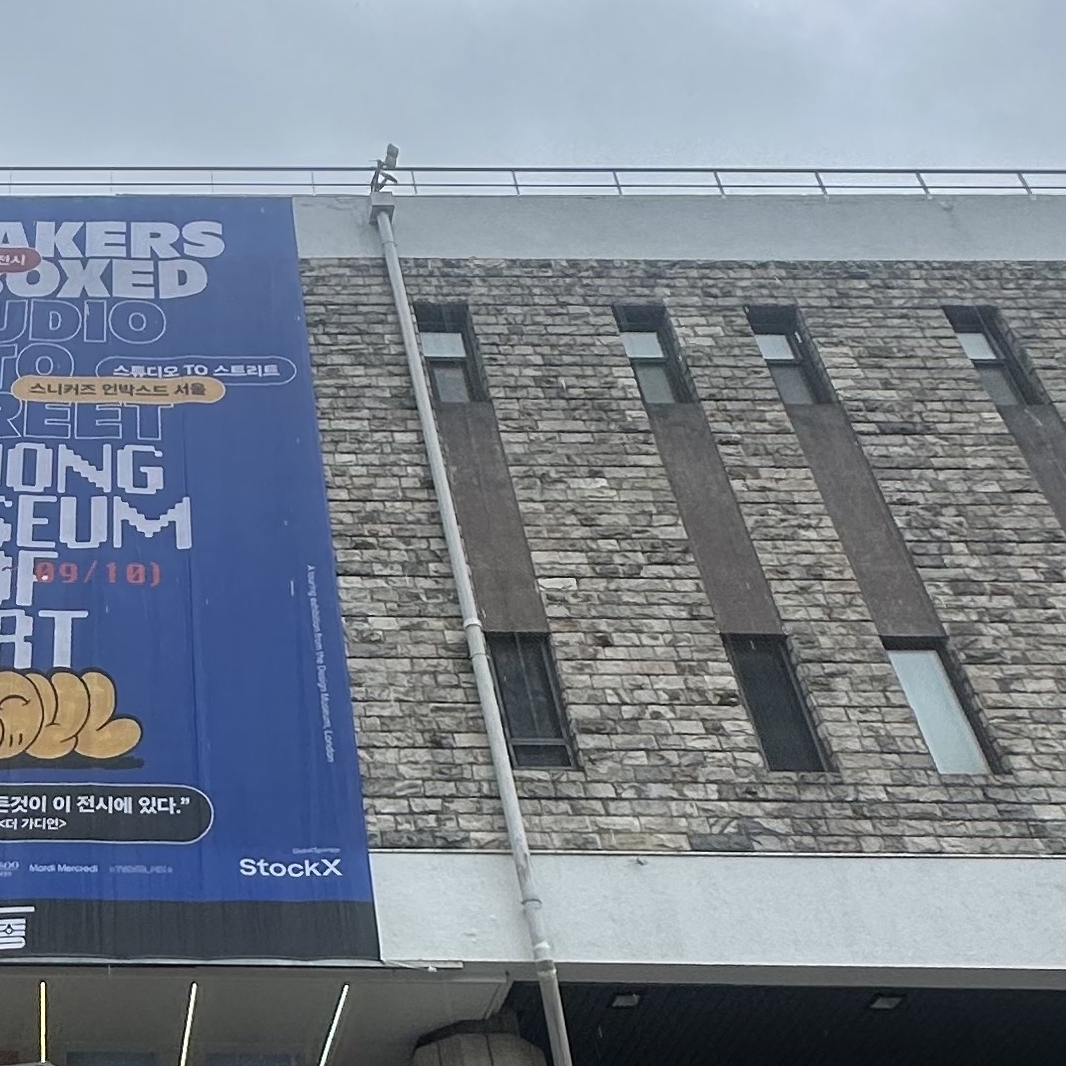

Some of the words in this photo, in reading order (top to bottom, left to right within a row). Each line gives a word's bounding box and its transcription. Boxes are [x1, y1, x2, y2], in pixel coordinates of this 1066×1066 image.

[112, 364, 180, 378] 스튜디오
[183, 364, 209, 377] TO
[213, 364, 280, 378] 스트리트
[30, 382, 97, 396] 스니커즈
[102, 382, 169, 397] 언박스드
[174, 382, 207, 397] 서울
[317, 665, 328, 692] Design
[324, 730, 336, 763] London
[52, 796, 71, 813] 이
[76, 796, 133, 815] 전시에
[239, 858, 343, 878] StockX
